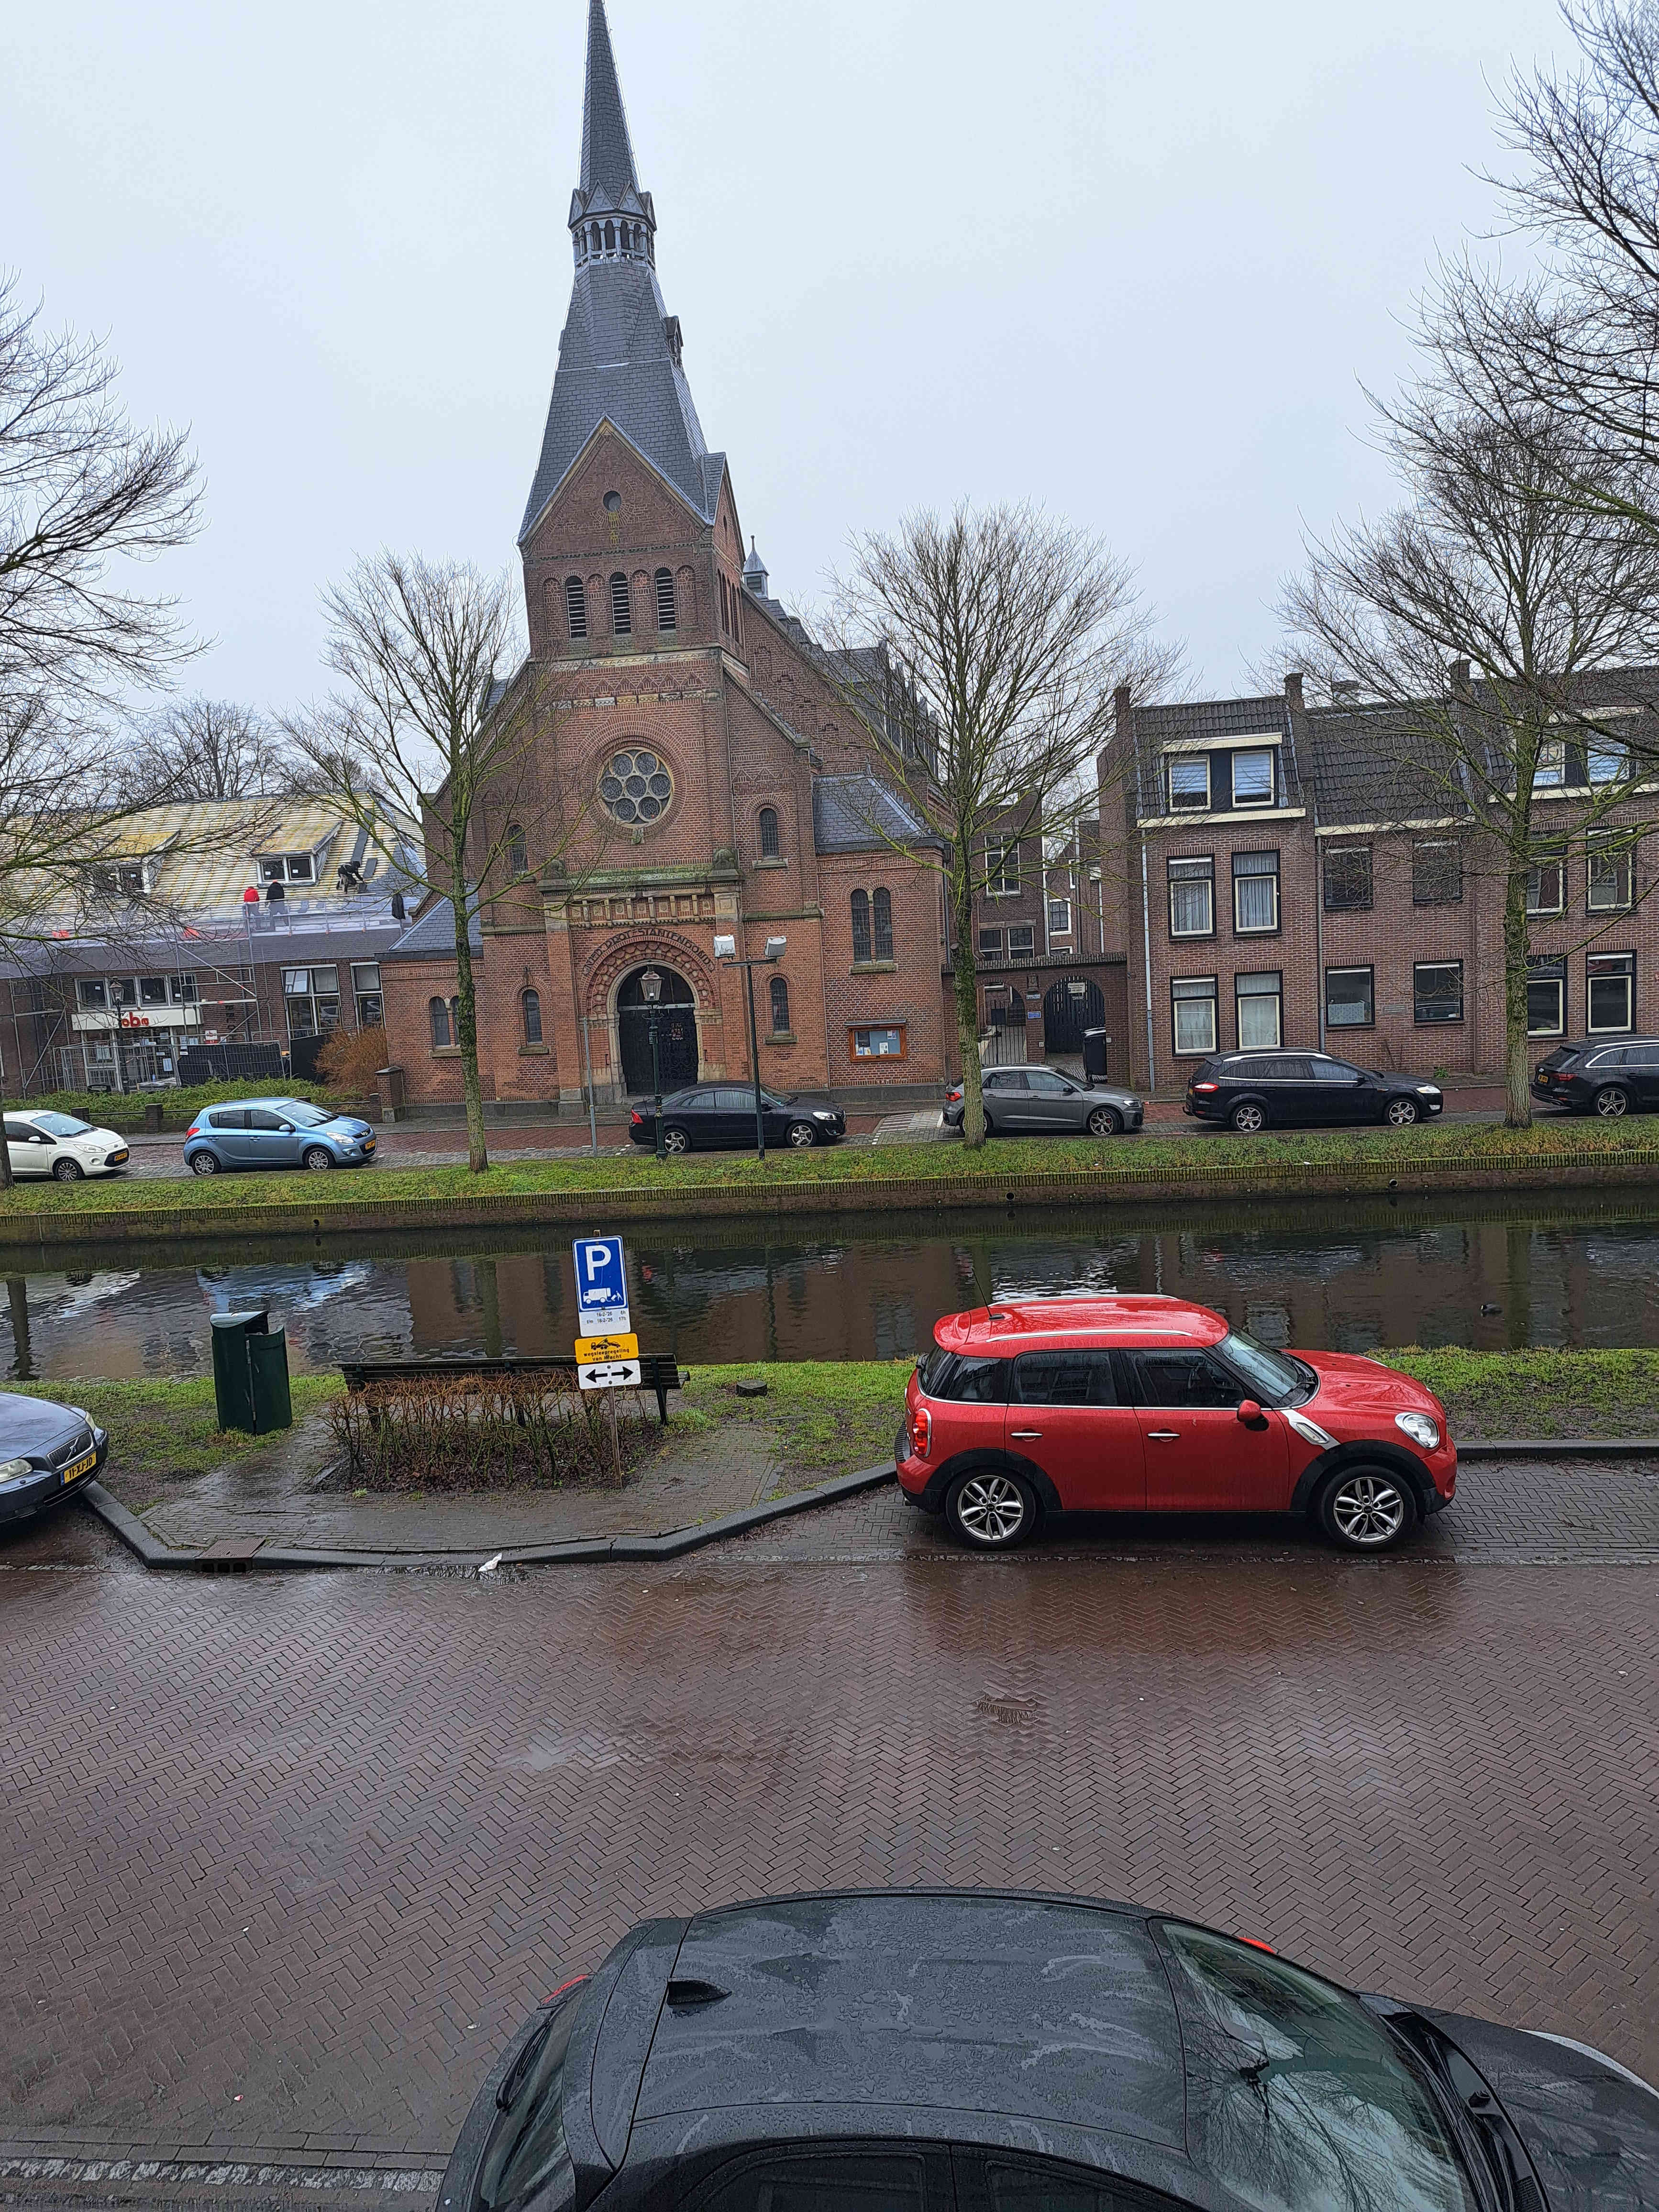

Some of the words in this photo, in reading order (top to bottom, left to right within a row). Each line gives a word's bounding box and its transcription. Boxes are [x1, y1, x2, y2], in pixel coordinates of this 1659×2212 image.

[585, 1245, 611, 1281] P
[584, 1348, 630, 1357] wegsleepregeling
[68, 1457, 93, 1479] 11-XJ-JD
